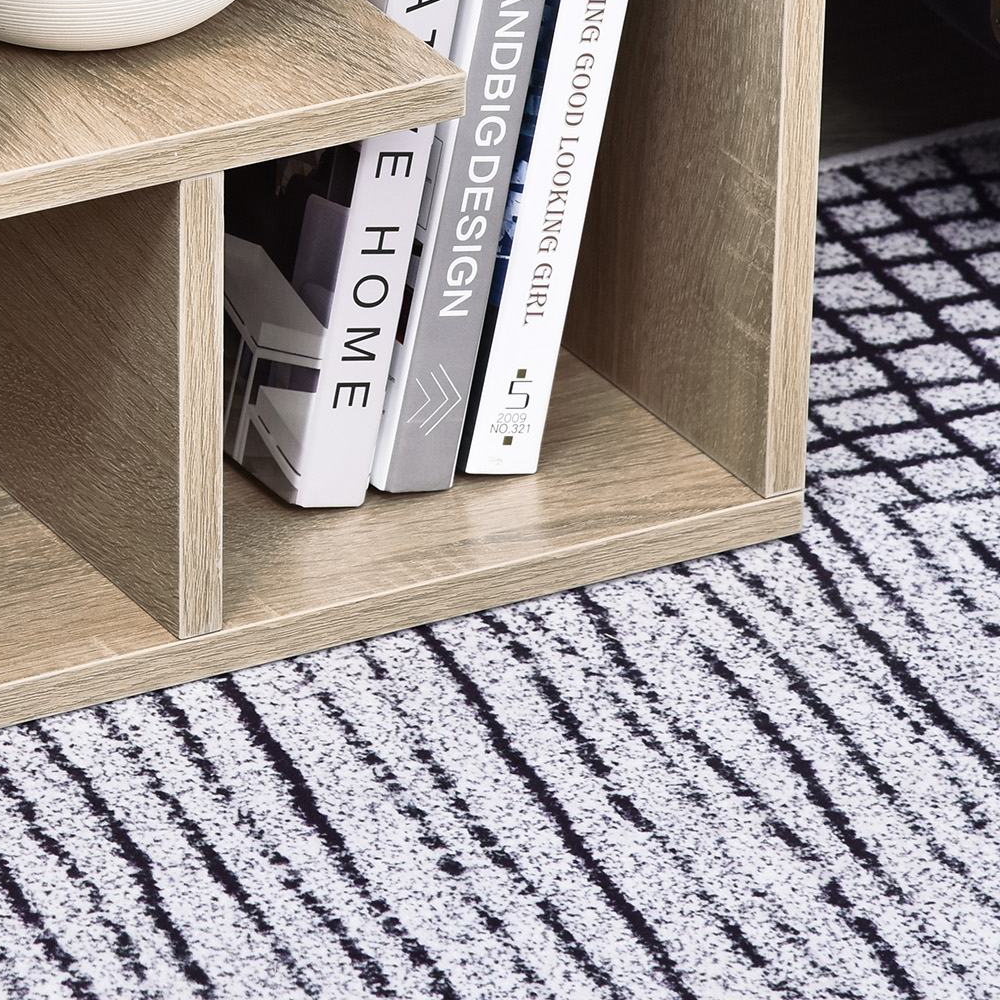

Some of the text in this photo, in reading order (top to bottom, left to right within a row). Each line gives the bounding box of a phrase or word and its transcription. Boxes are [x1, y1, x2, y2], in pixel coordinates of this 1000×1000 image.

[565, 53, 595, 126] GOOD
[439, 155, 501, 318] DESIGN
[539, 137, 580, 254] LOOKING
[332, 226, 399, 408] HOME
[523, 263, 553, 327] GIRL
[496, 412, 527, 423] 2009
